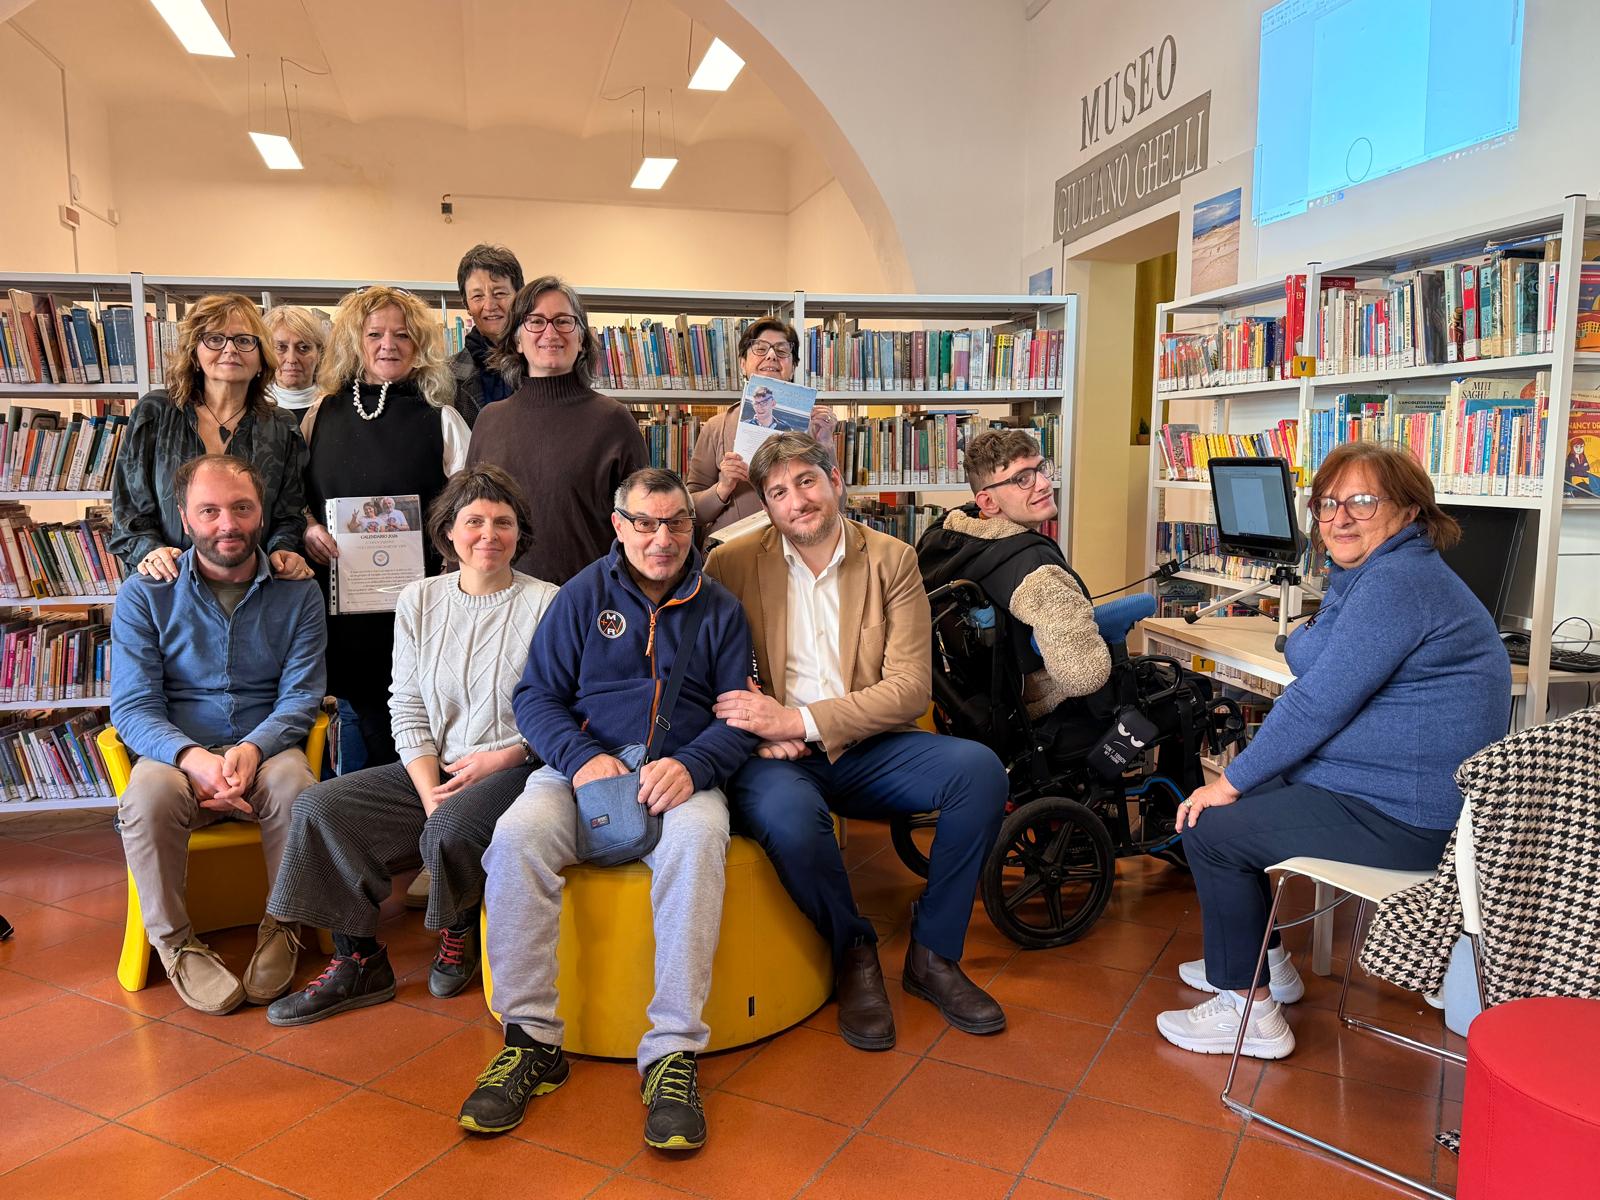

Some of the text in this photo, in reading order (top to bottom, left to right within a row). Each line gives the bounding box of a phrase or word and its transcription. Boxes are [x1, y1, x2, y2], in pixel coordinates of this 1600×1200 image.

[1080, 34, 1177, 152] MUSEO
[1056, 152, 1130, 236] GIULIANO
[1134, 110, 1205, 200] GHELLI
[1300, 361, 1307, 371] V
